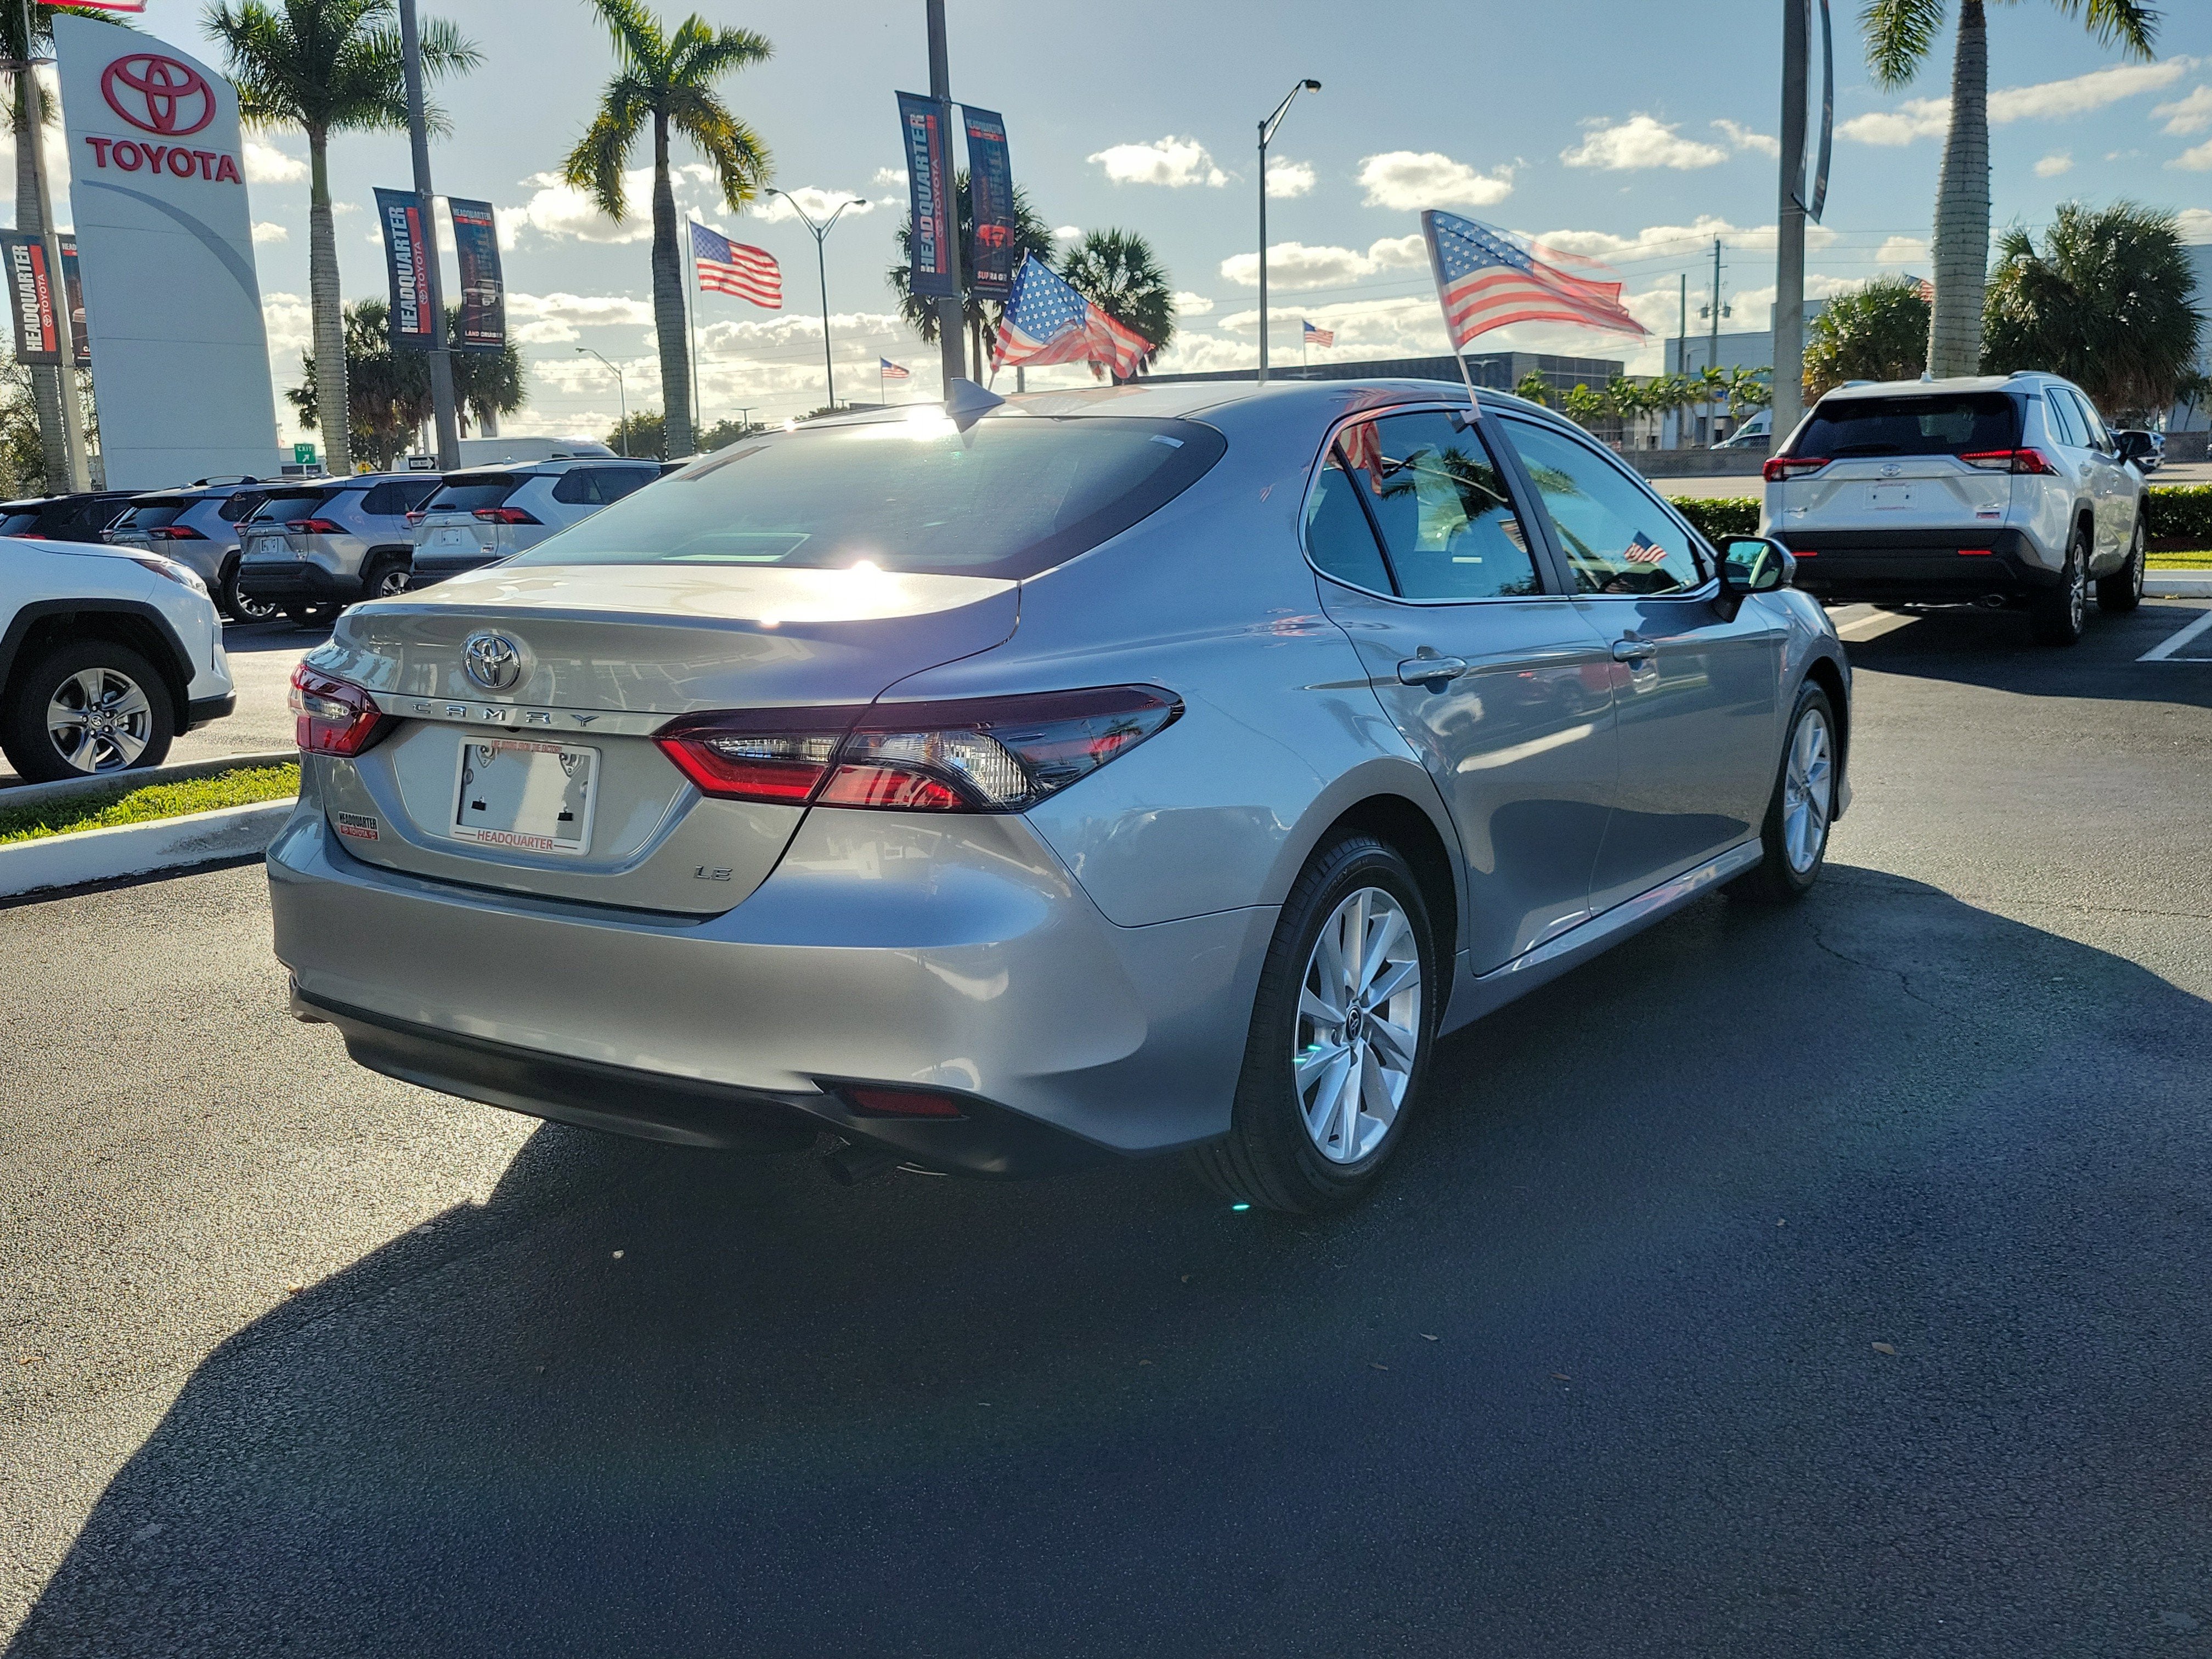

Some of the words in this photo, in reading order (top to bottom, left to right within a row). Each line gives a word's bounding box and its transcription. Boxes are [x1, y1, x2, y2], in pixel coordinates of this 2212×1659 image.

[86, 137, 242, 184] TOYOTA
[910, 114, 935, 273] HEADQUARTER
[932, 159, 941, 217] TOYOTA
[388, 206, 419, 333] HEADQUARTER
[414, 242, 426, 289] TOYOTA
[12, 245, 43, 352] HEADQUARTER
[38, 274, 50, 314] TOYOTA
[413, 702, 600, 727] CAMRY
[338, 812, 377, 830] HEADQUARTER
[349, 827, 368, 838] TOYOTA
[477, 830, 553, 850] HEADQUARTER
[693, 865, 733, 881] LE
